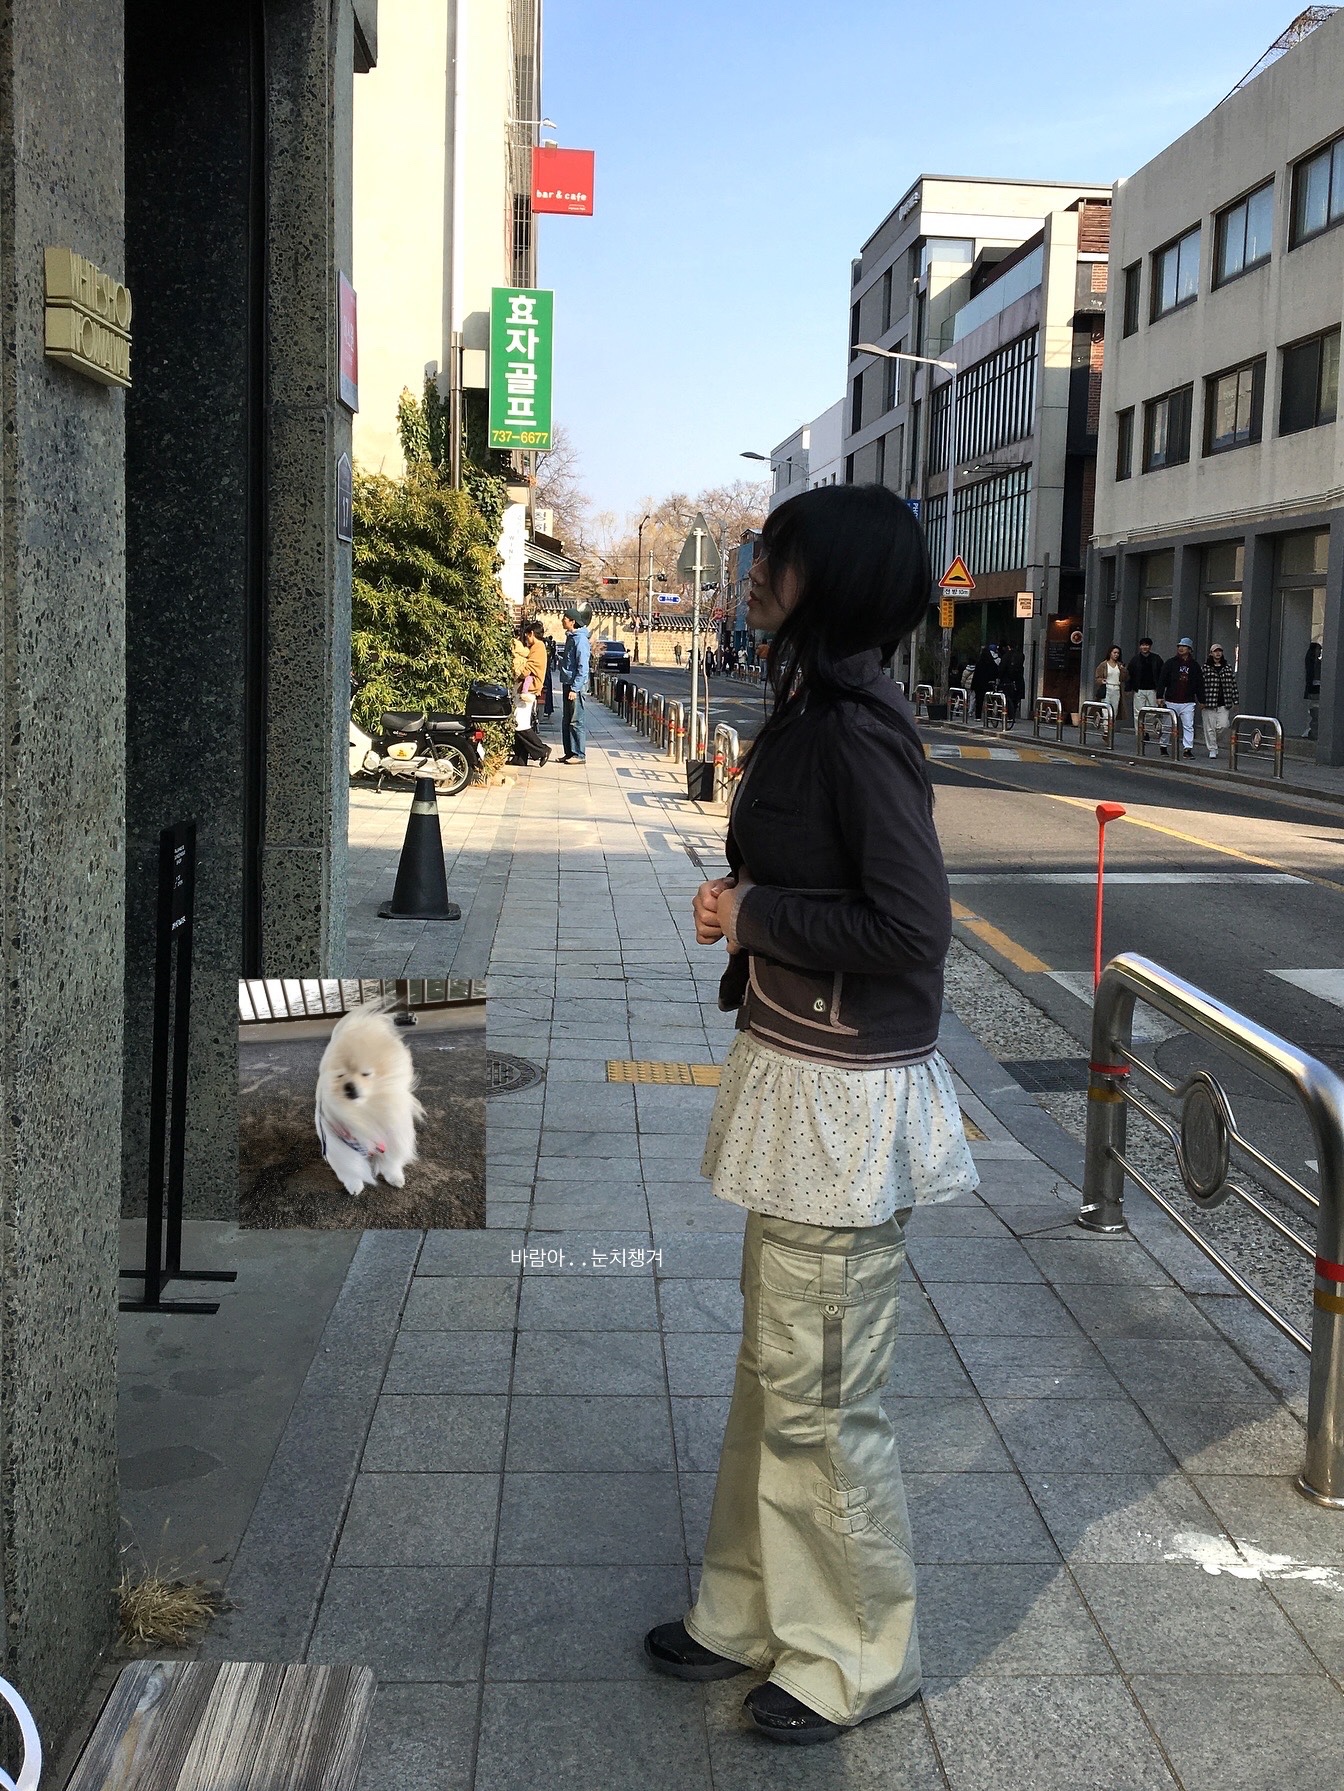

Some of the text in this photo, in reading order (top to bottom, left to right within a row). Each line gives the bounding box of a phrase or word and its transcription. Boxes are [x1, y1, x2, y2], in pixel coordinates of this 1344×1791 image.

[536, 189, 587, 202] bar & cafe
[504, 294, 540, 426] 효자골프
[491, 430, 548, 444] 737-6677
